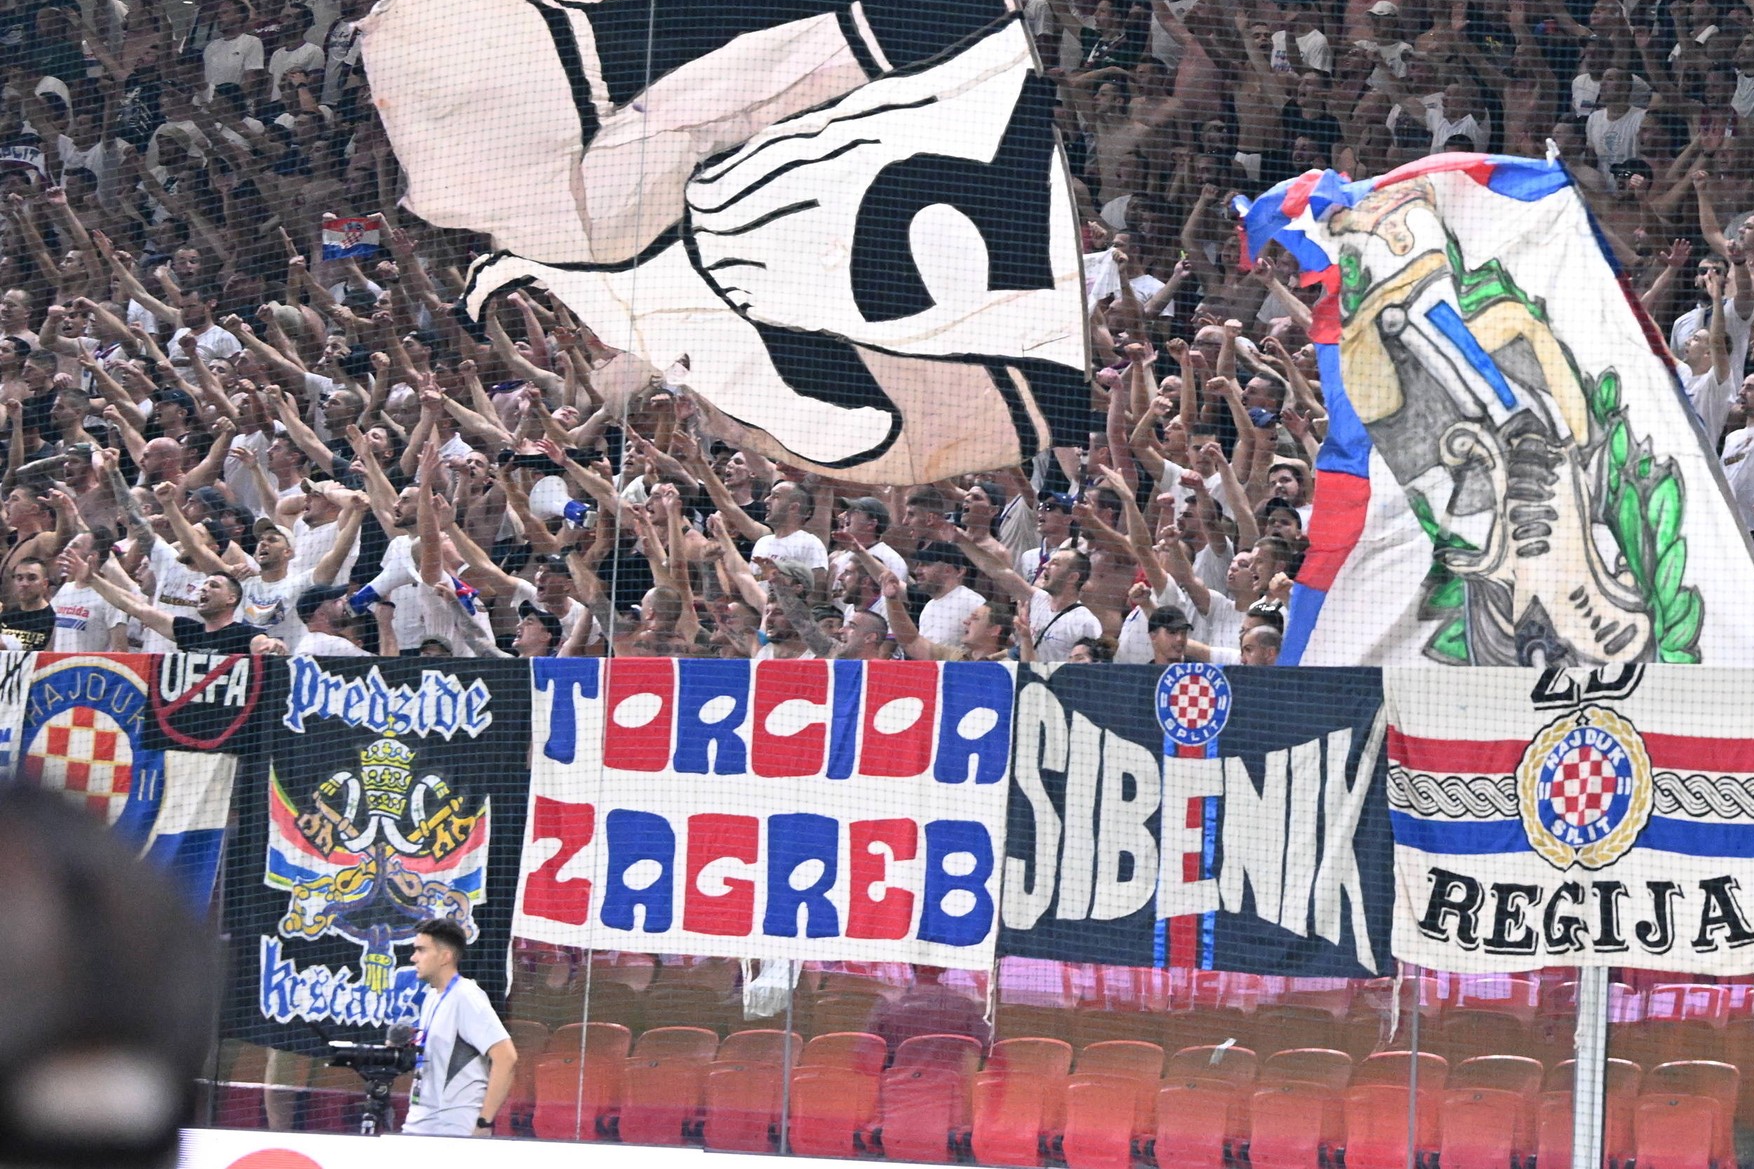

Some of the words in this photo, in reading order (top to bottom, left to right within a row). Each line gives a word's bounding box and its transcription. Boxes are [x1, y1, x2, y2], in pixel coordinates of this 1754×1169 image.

[161, 652, 250, 707] UEFA
[1164, 663, 1225, 689] HAJDUK
[533, 657, 1014, 784] TORCIDA
[1164, 717, 1218, 741] SPLIT
[1546, 729, 1626, 771] HAJDUK
[522, 795, 994, 946] ZAGREB
